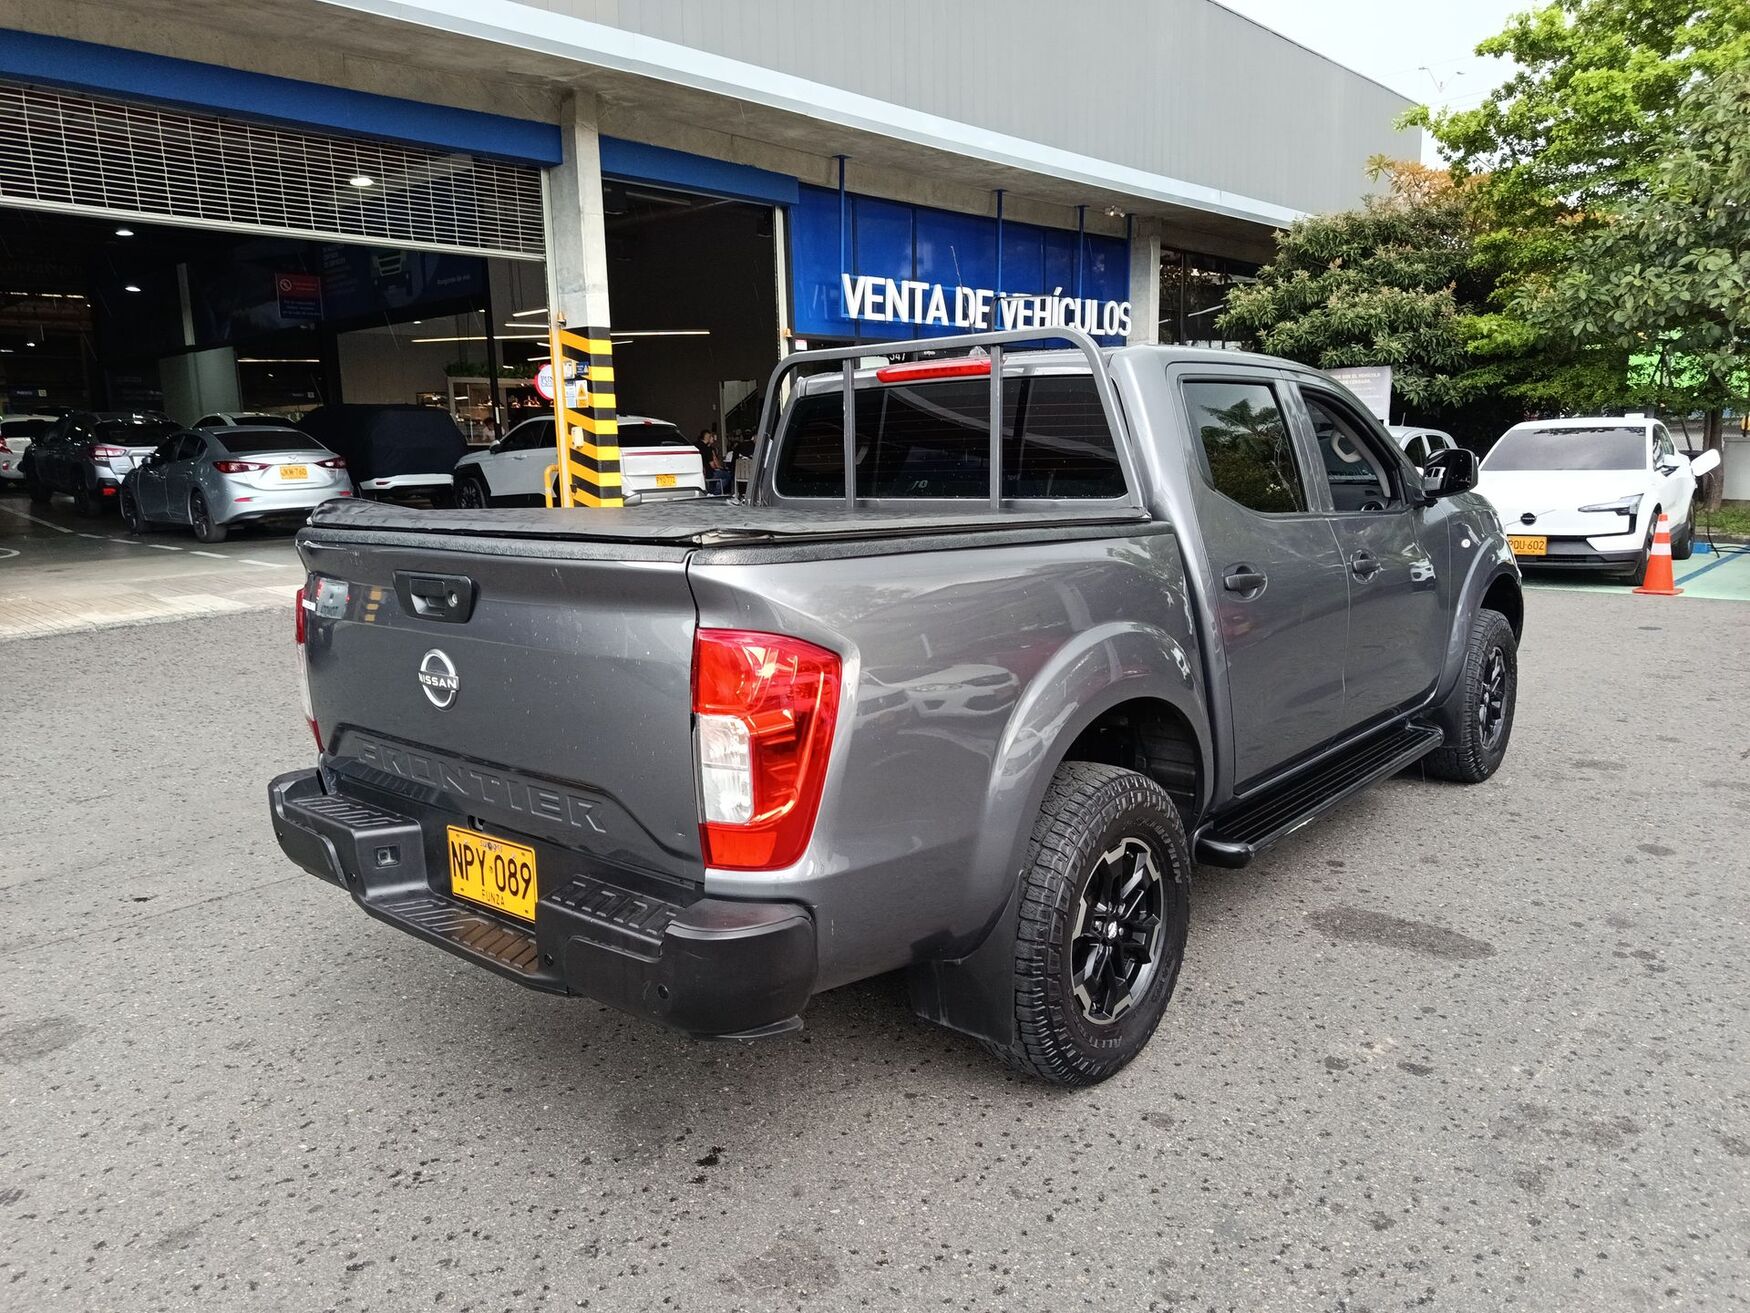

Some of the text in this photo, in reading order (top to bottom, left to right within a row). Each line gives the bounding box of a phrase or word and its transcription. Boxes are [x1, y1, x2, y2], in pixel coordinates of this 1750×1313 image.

[841, 273, 1132, 336] VENTA DE VEHÍCULOS
[418, 672, 457, 689] NISSAN
[355, 735, 607, 834] FRONTIER
[450, 840, 532, 900] NPY 089
[481, 888, 505, 907] FUNZA
